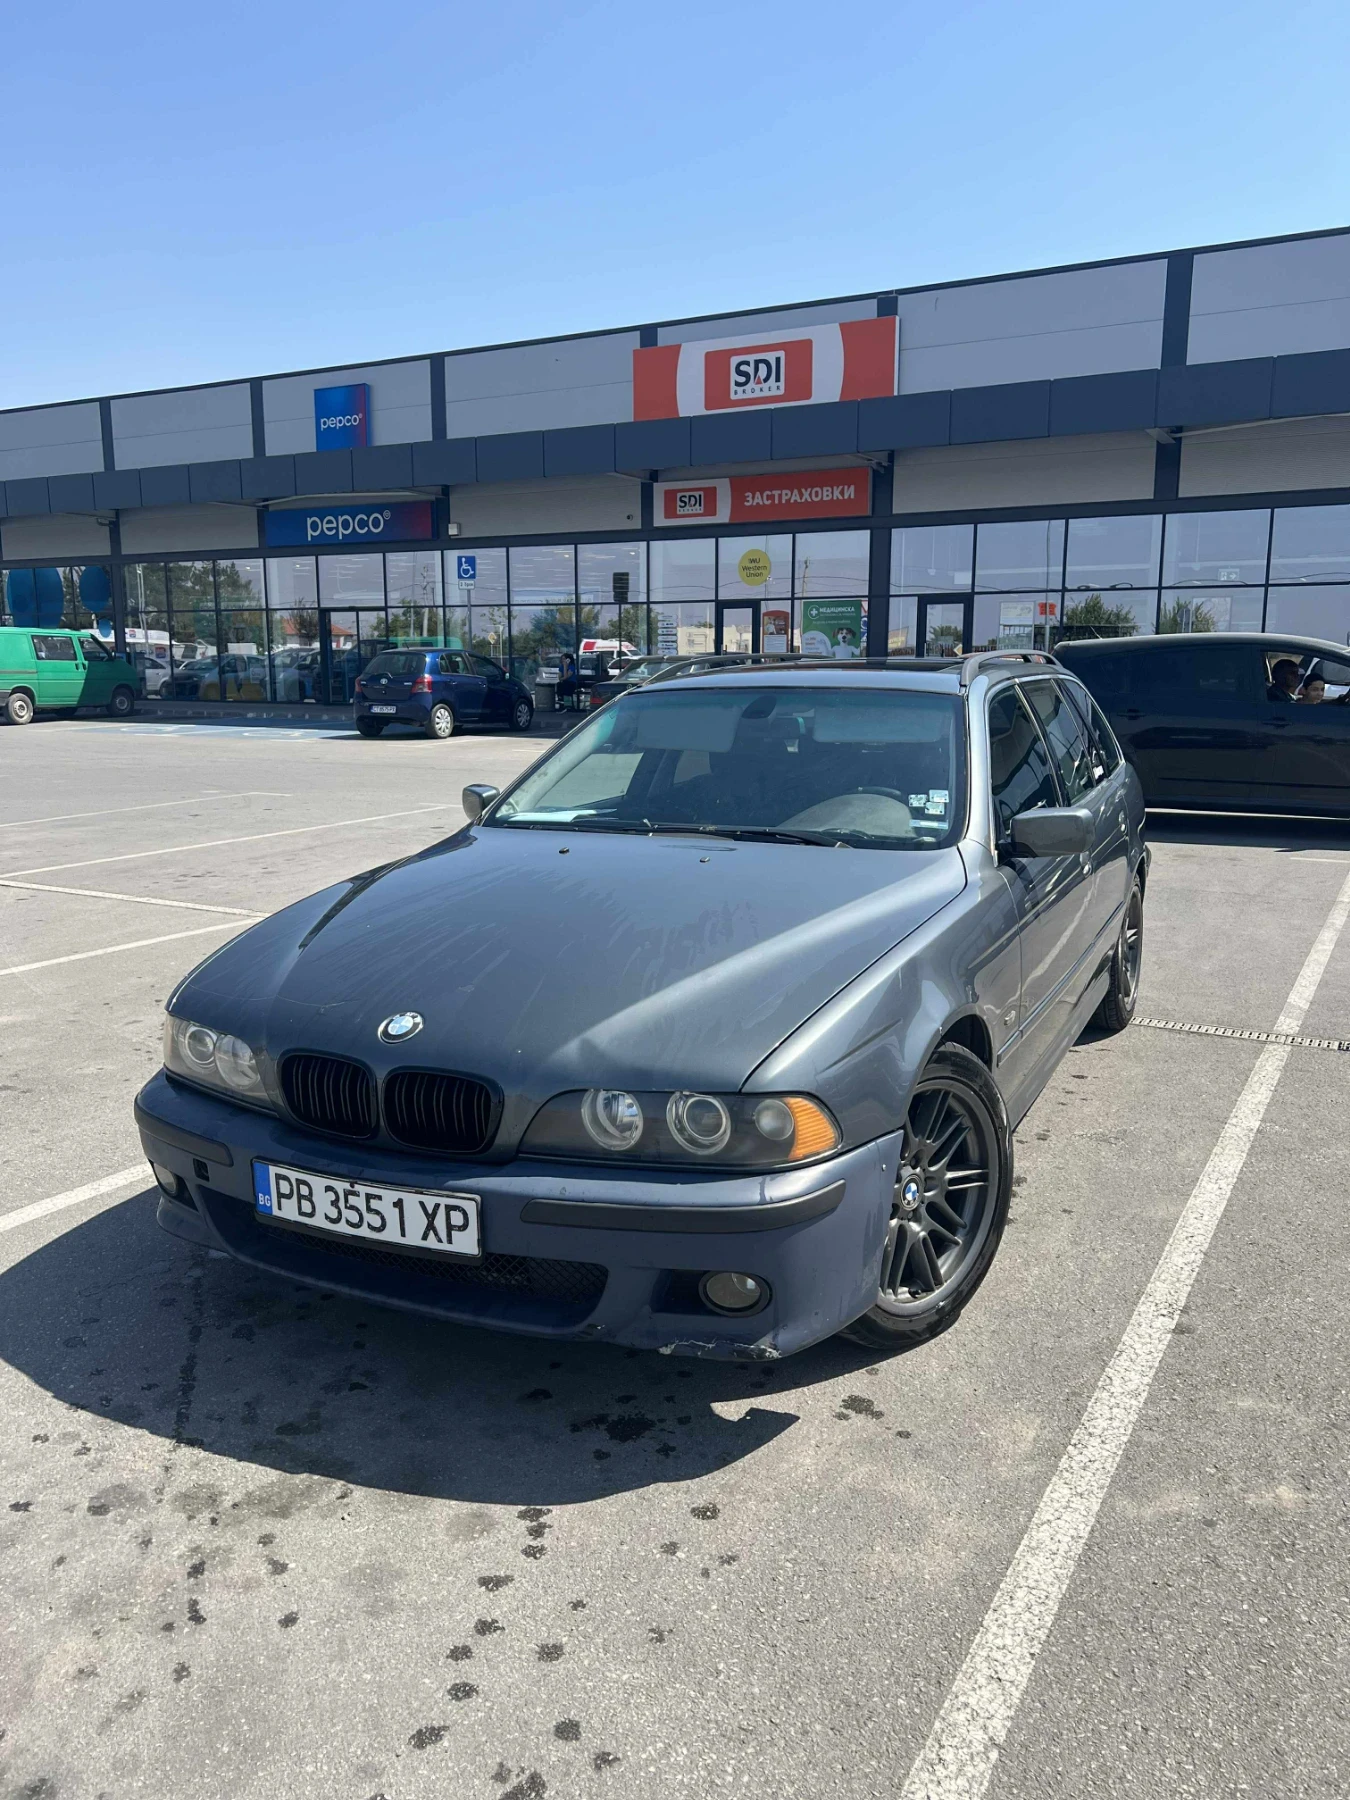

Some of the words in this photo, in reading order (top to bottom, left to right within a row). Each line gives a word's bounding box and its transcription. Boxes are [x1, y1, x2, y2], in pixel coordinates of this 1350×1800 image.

[735, 356, 781, 387] SDI
[734, 385, 781, 396] BROKER
[678, 494, 702, 508] SDI
[744, 484, 855, 506] ЗАСТРАХОВКИ
[741, 564, 768, 572] Western
[258, 1192, 271, 1207] BG
[274, 1172, 317, 1219] PB
[324, 1184, 407, 1239] 3551
[418, 1199, 470, 1245] XP
